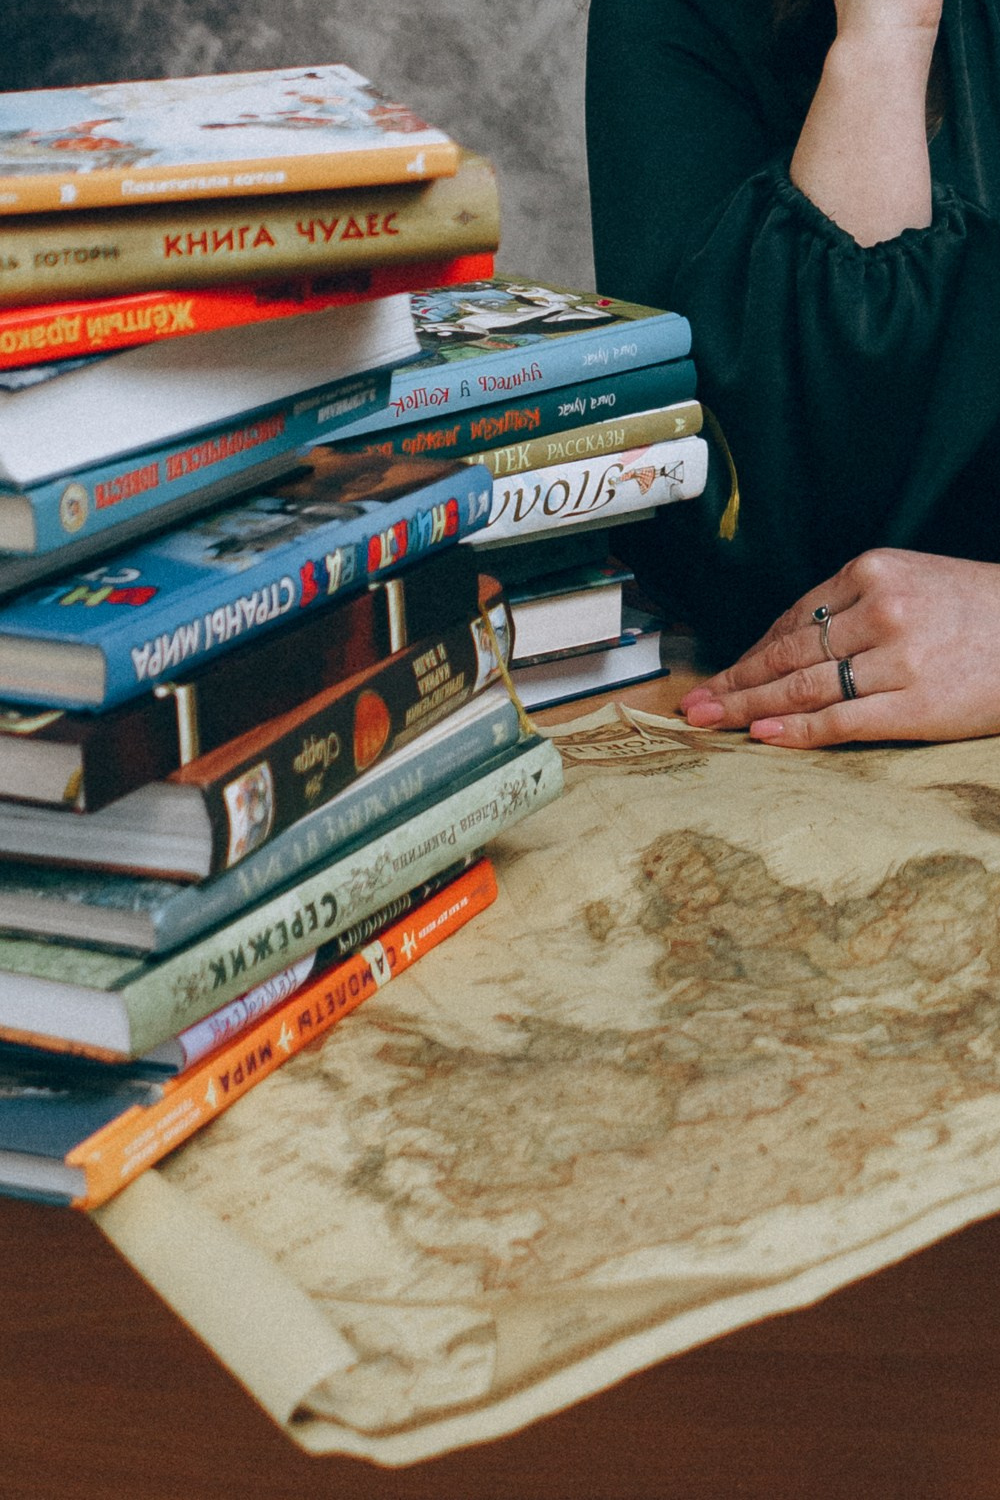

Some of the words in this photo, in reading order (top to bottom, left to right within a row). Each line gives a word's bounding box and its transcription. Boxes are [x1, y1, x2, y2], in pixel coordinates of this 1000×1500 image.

[33, 245, 119, 268] ГОТОРН
[163, 224, 276, 259] КНИГА
[296, 212, 400, 244] ЧУДЕС
[86, 299, 195, 347] Жёлтый
[493, 445, 532, 475] ГЕК
[547, 429, 625, 461] РАССКАЗЫ
[200, 575, 296, 652] СТРАНЫ
[131, 623, 199, 682] МИРА
[460, 797, 500, 837] Елена
[393, 823, 458, 873] Ракитина
[219, 1043, 273, 1094] МИРА
